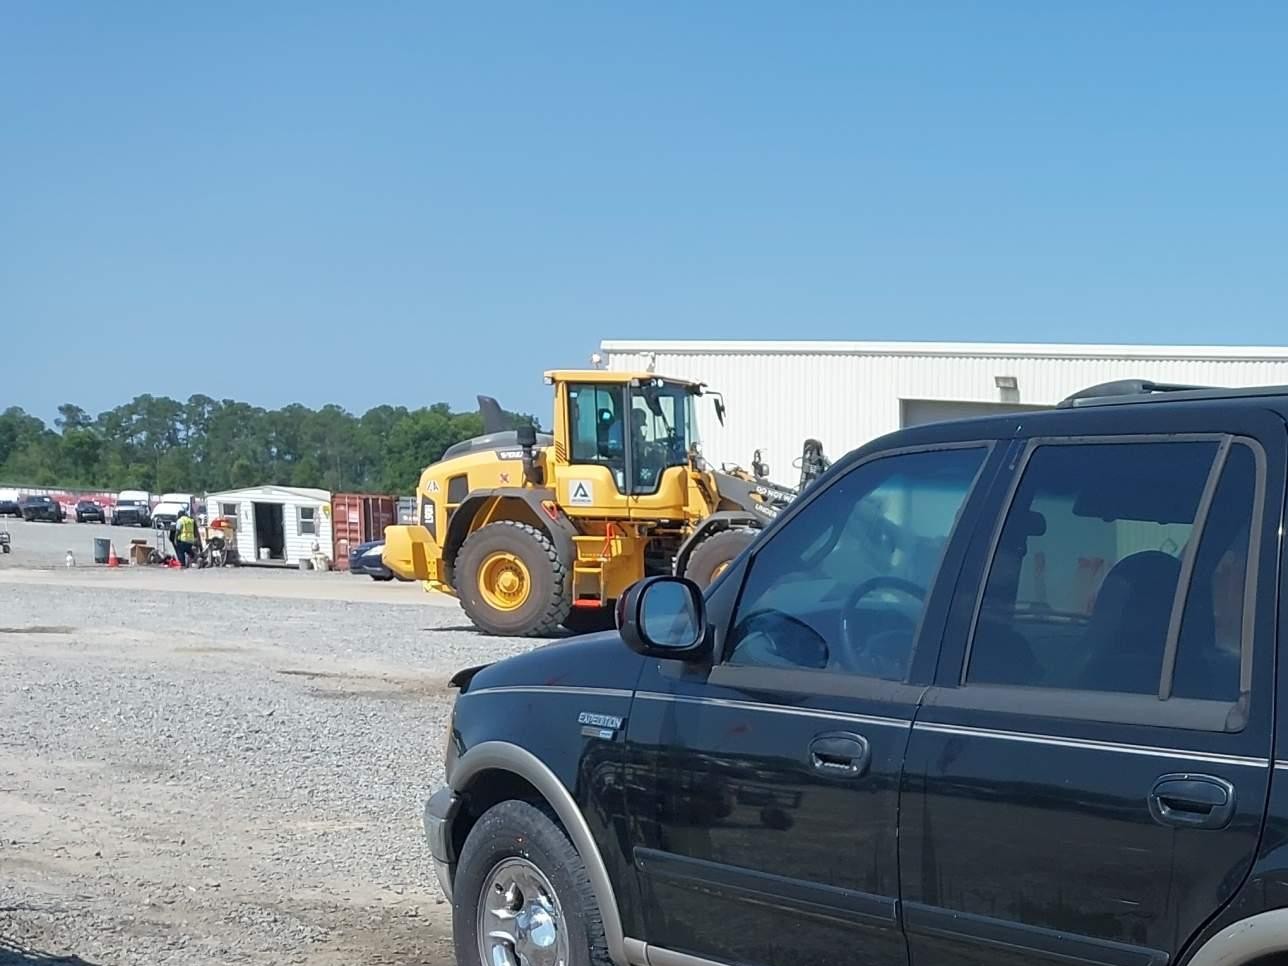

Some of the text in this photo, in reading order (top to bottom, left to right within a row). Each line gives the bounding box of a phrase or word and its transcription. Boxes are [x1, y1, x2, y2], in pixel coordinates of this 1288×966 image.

[756, 486, 767, 494] DO
[768, 489, 782, 499] NOT
[578, 712, 622, 728] EXPEDITION
